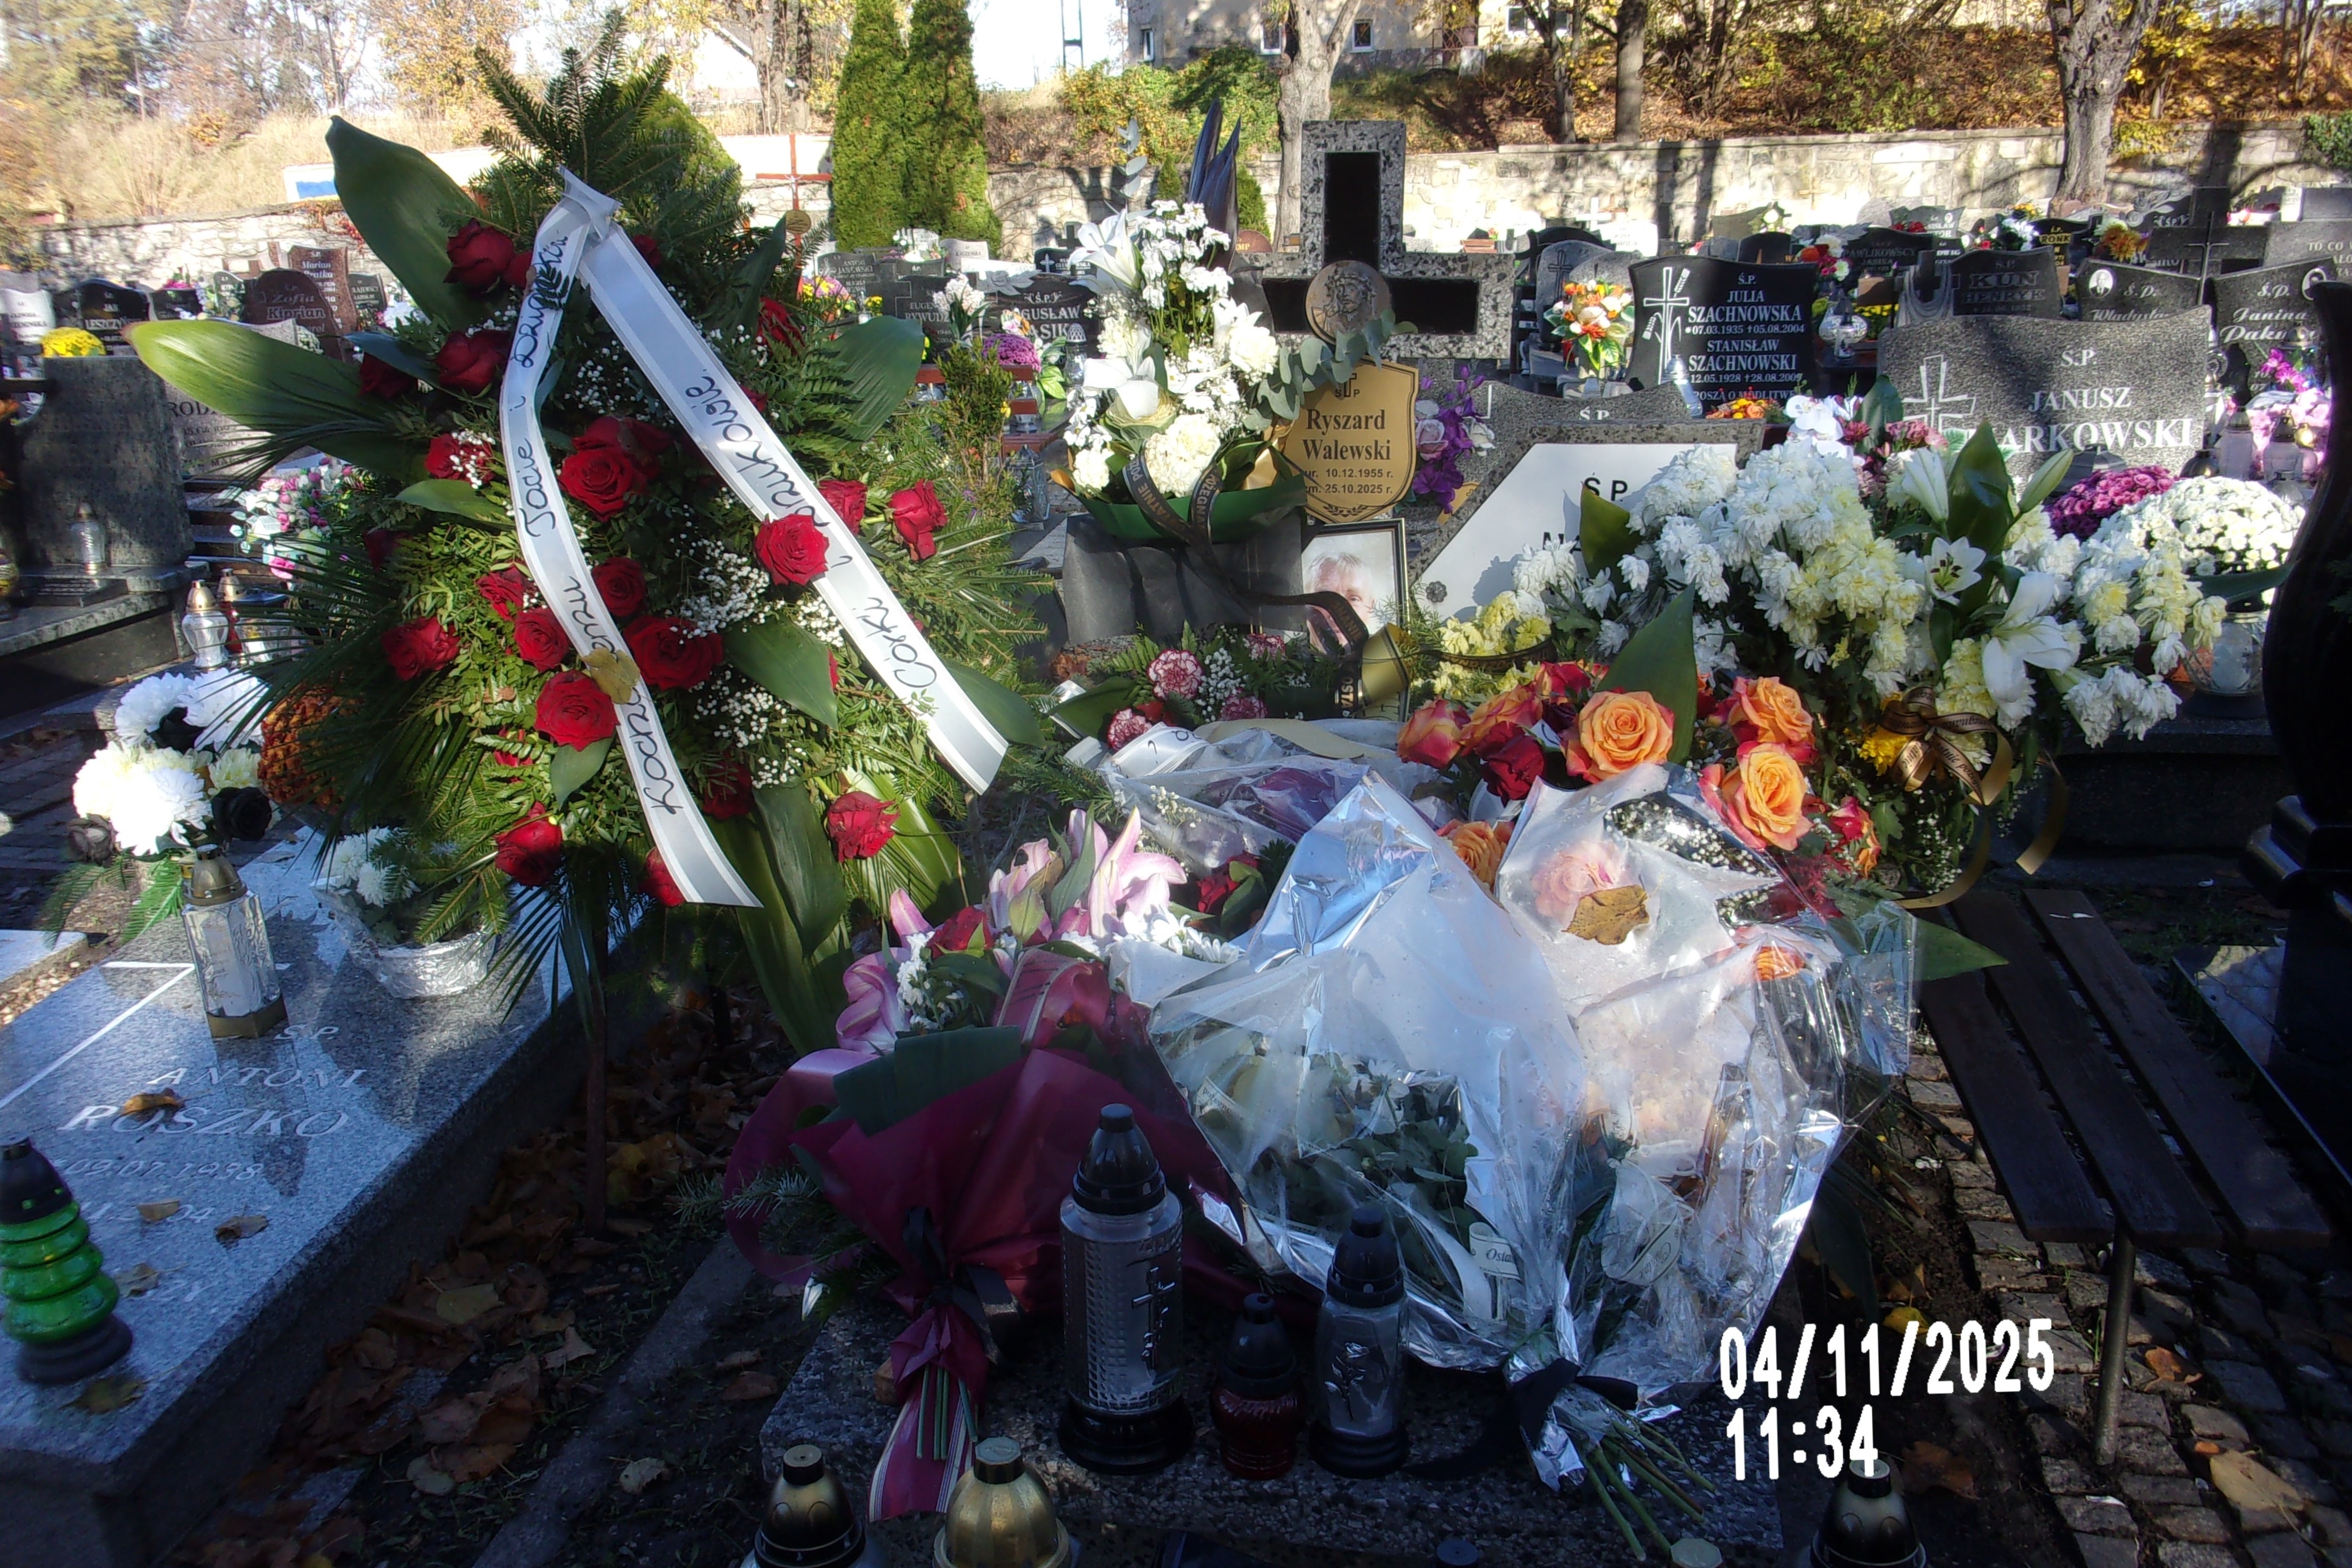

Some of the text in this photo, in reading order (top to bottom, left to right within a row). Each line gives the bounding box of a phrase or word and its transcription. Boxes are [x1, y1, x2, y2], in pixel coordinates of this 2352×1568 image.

[2307, 242, 2344, 251] TO CO
[1739, 272, 1757, 285] Ś.P.
[1727, 290, 1765, 303] JULIA
[267, 305, 326, 320] Kiprian
[1019, 304, 1081, 321] GUSŁAW
[1688, 304, 1802, 323] SZACHNOWSKA
[2232, 307, 2307, 323] Janina
[1707, 339, 1780, 352] STANISŁAW
[1689, 354, 1797, 372] SZACHNOWSKI
[1690, 373, 1741, 384] 12.05.1928
[1728, 391, 1736, 400] O
[2028, 386, 2132, 412] JANUSZ
[1306, 408, 1386, 436] Ryszard
[1998, 417, 2194, 453] ARKOWSKI
[1302, 439, 1392, 461] Walewski
[1325, 468, 1384, 479] 10.12.1955
[1385, 470, 1394, 479] r.
[1324, 483, 1383, 495] 25.10.2025
[1385, 485, 1393, 494] r.
[851, 597, 938, 689] Córki
[147, 1067, 368, 1089] ANTONI
